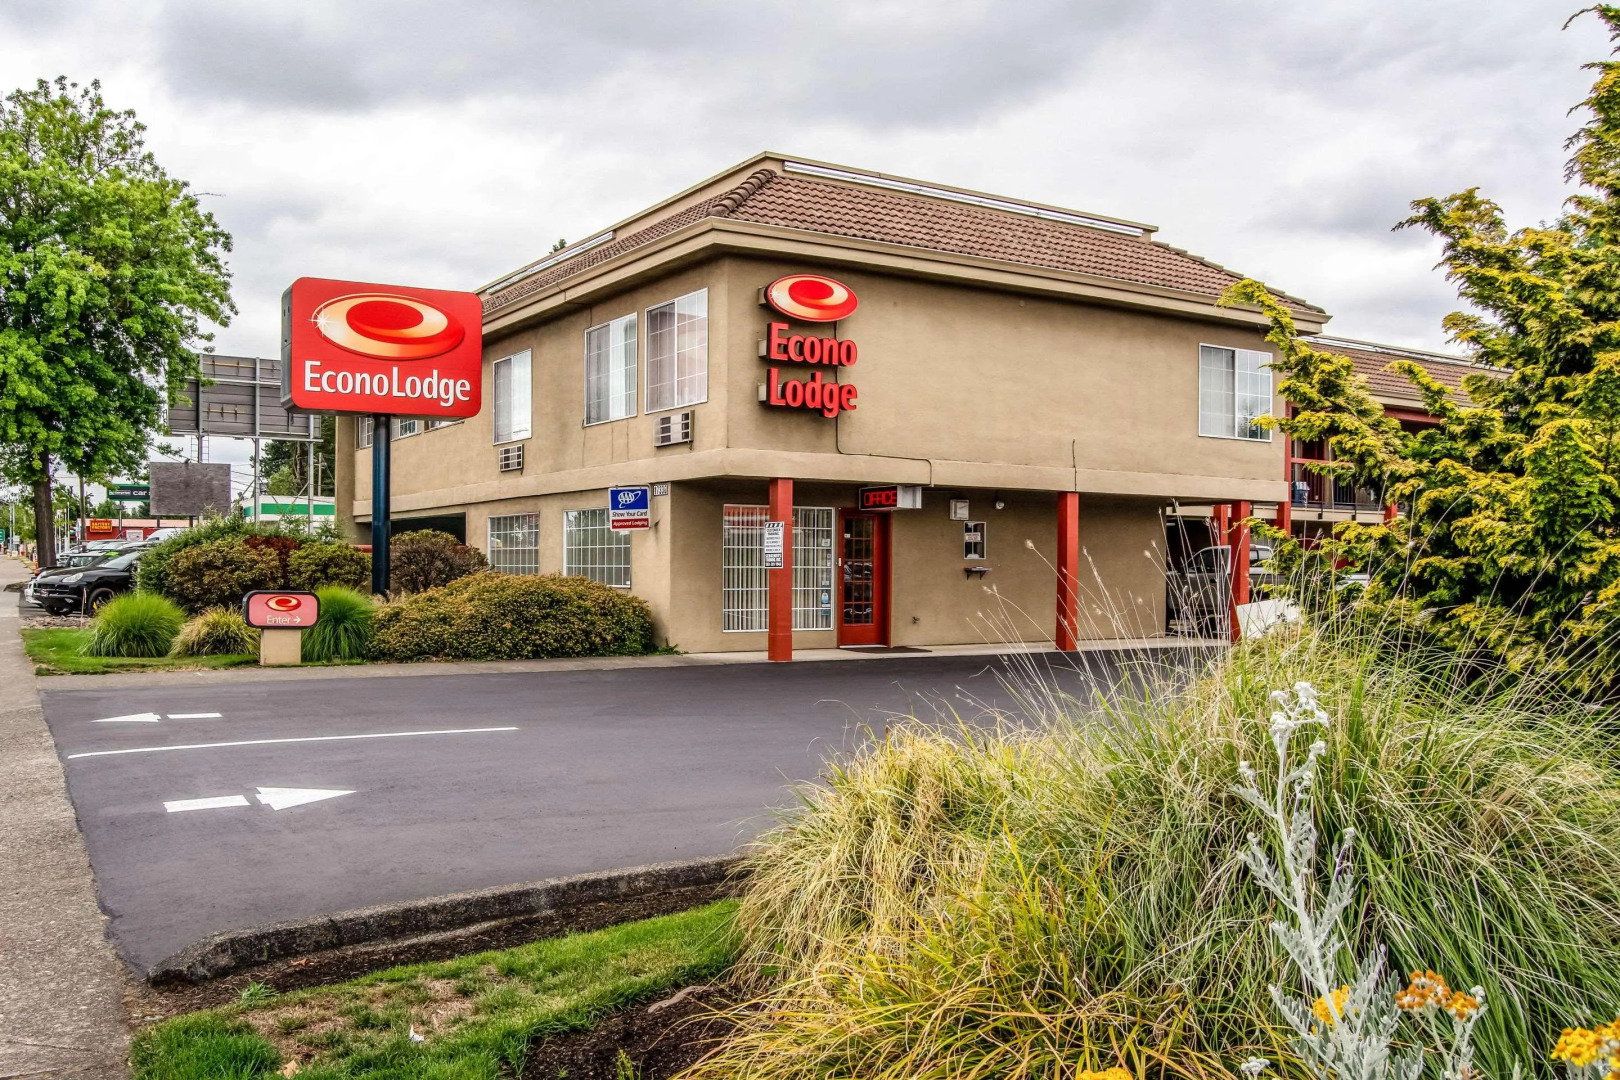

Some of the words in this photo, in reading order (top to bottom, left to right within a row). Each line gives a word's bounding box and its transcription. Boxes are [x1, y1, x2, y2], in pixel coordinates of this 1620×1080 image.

[769, 321, 858, 366] Econo
[769, 367, 858, 418] Lodge
[864, 490, 897, 506] OFFICE
[266, 615, 292, 624] Enter
